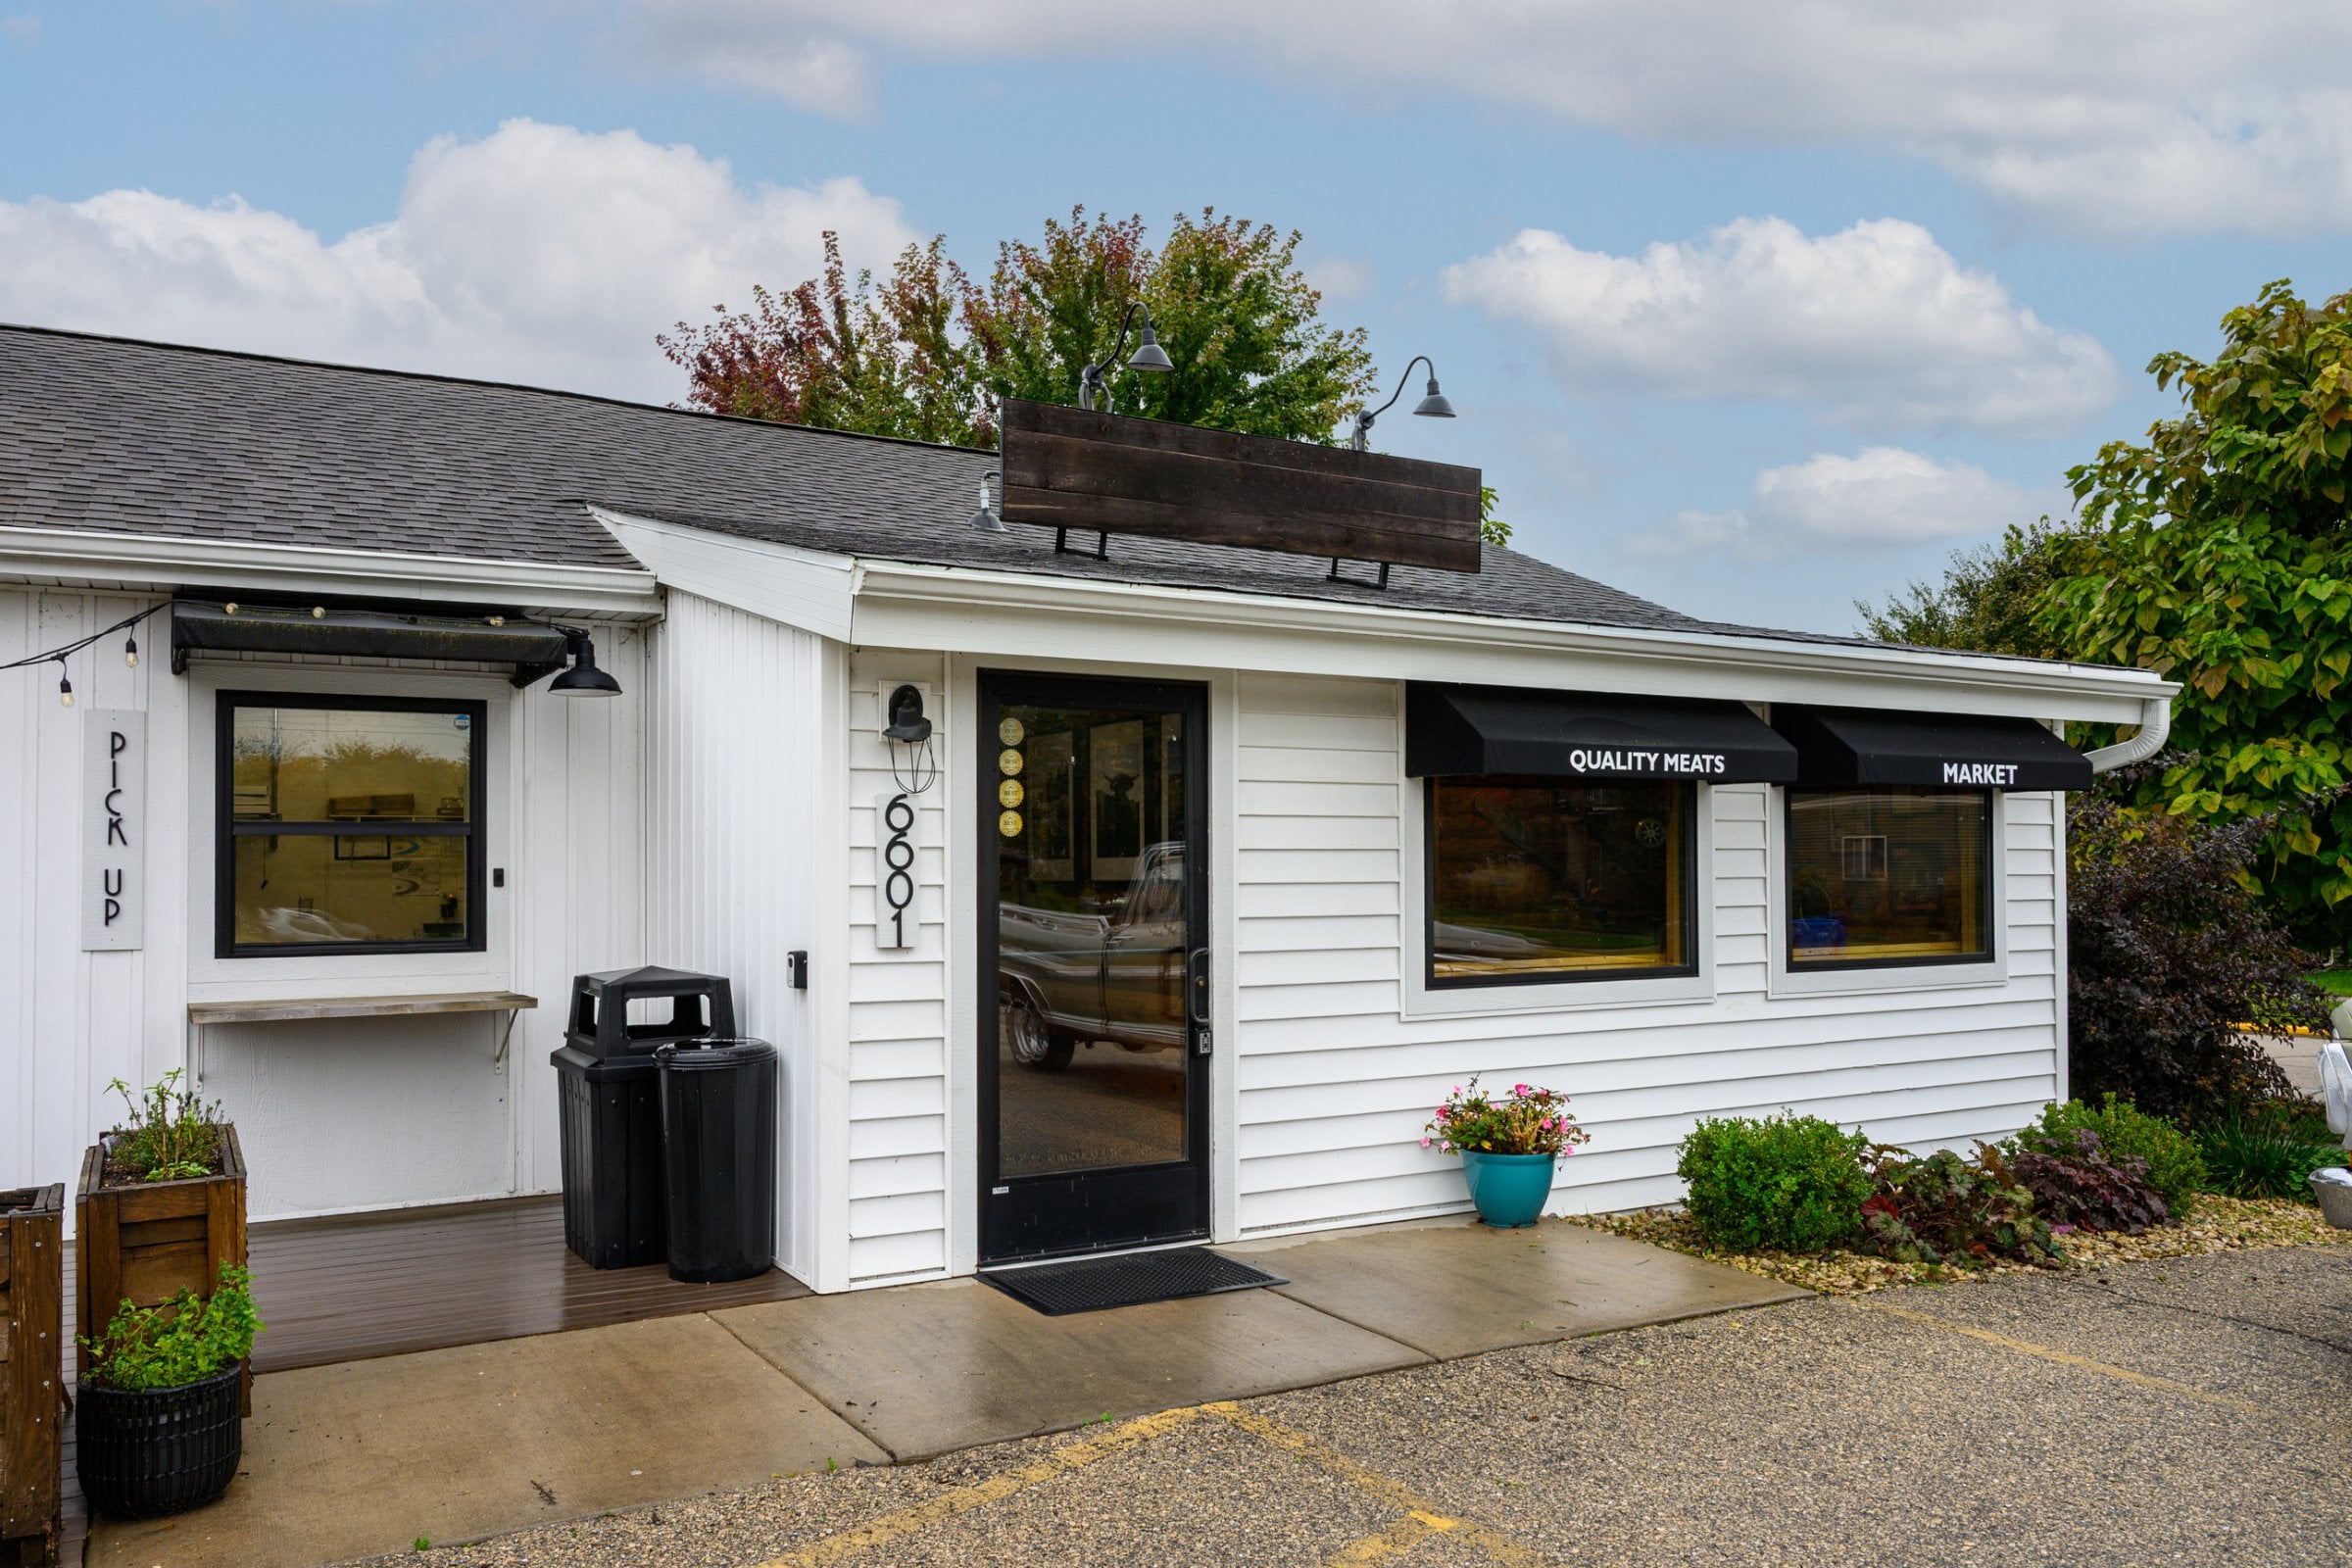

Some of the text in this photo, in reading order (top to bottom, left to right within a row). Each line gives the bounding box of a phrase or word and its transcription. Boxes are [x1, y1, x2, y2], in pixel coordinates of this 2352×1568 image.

[1569, 749, 1725, 773] QUALITY MEATS
[1943, 762, 2019, 785] MARKET
[104, 731, 127, 927] PICK UP
[885, 793, 914, 948] 6601
